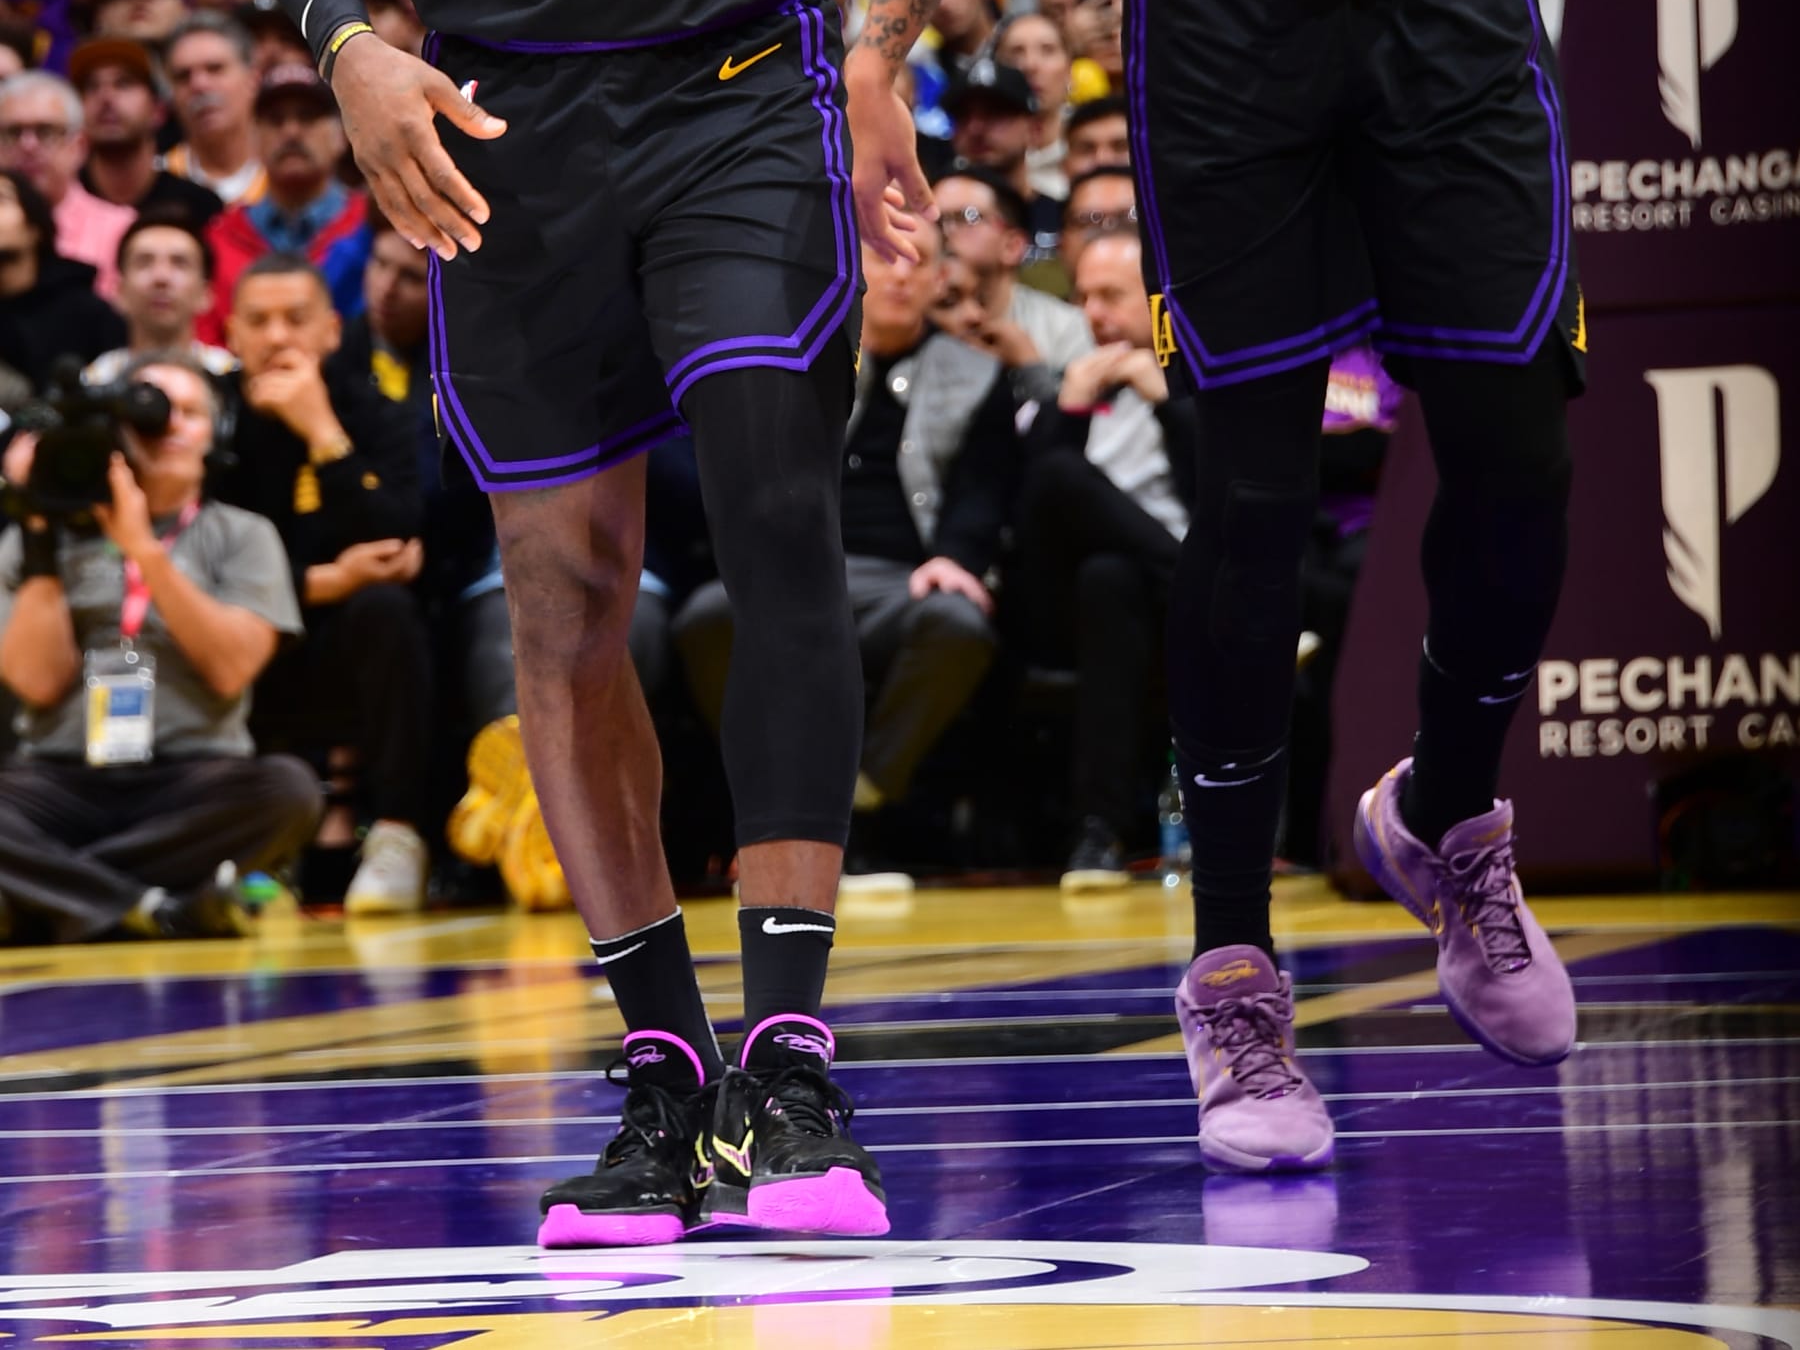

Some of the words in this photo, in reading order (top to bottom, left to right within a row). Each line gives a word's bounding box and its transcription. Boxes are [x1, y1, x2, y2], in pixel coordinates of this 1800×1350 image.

[1570, 148, 1800, 202] PECHANG
[1572, 201, 1692, 233] RESORT
[1537, 652, 1800, 716] PECHAN
[1539, 714, 1715, 758] RESORT
[1737, 711, 1800, 751] CA
